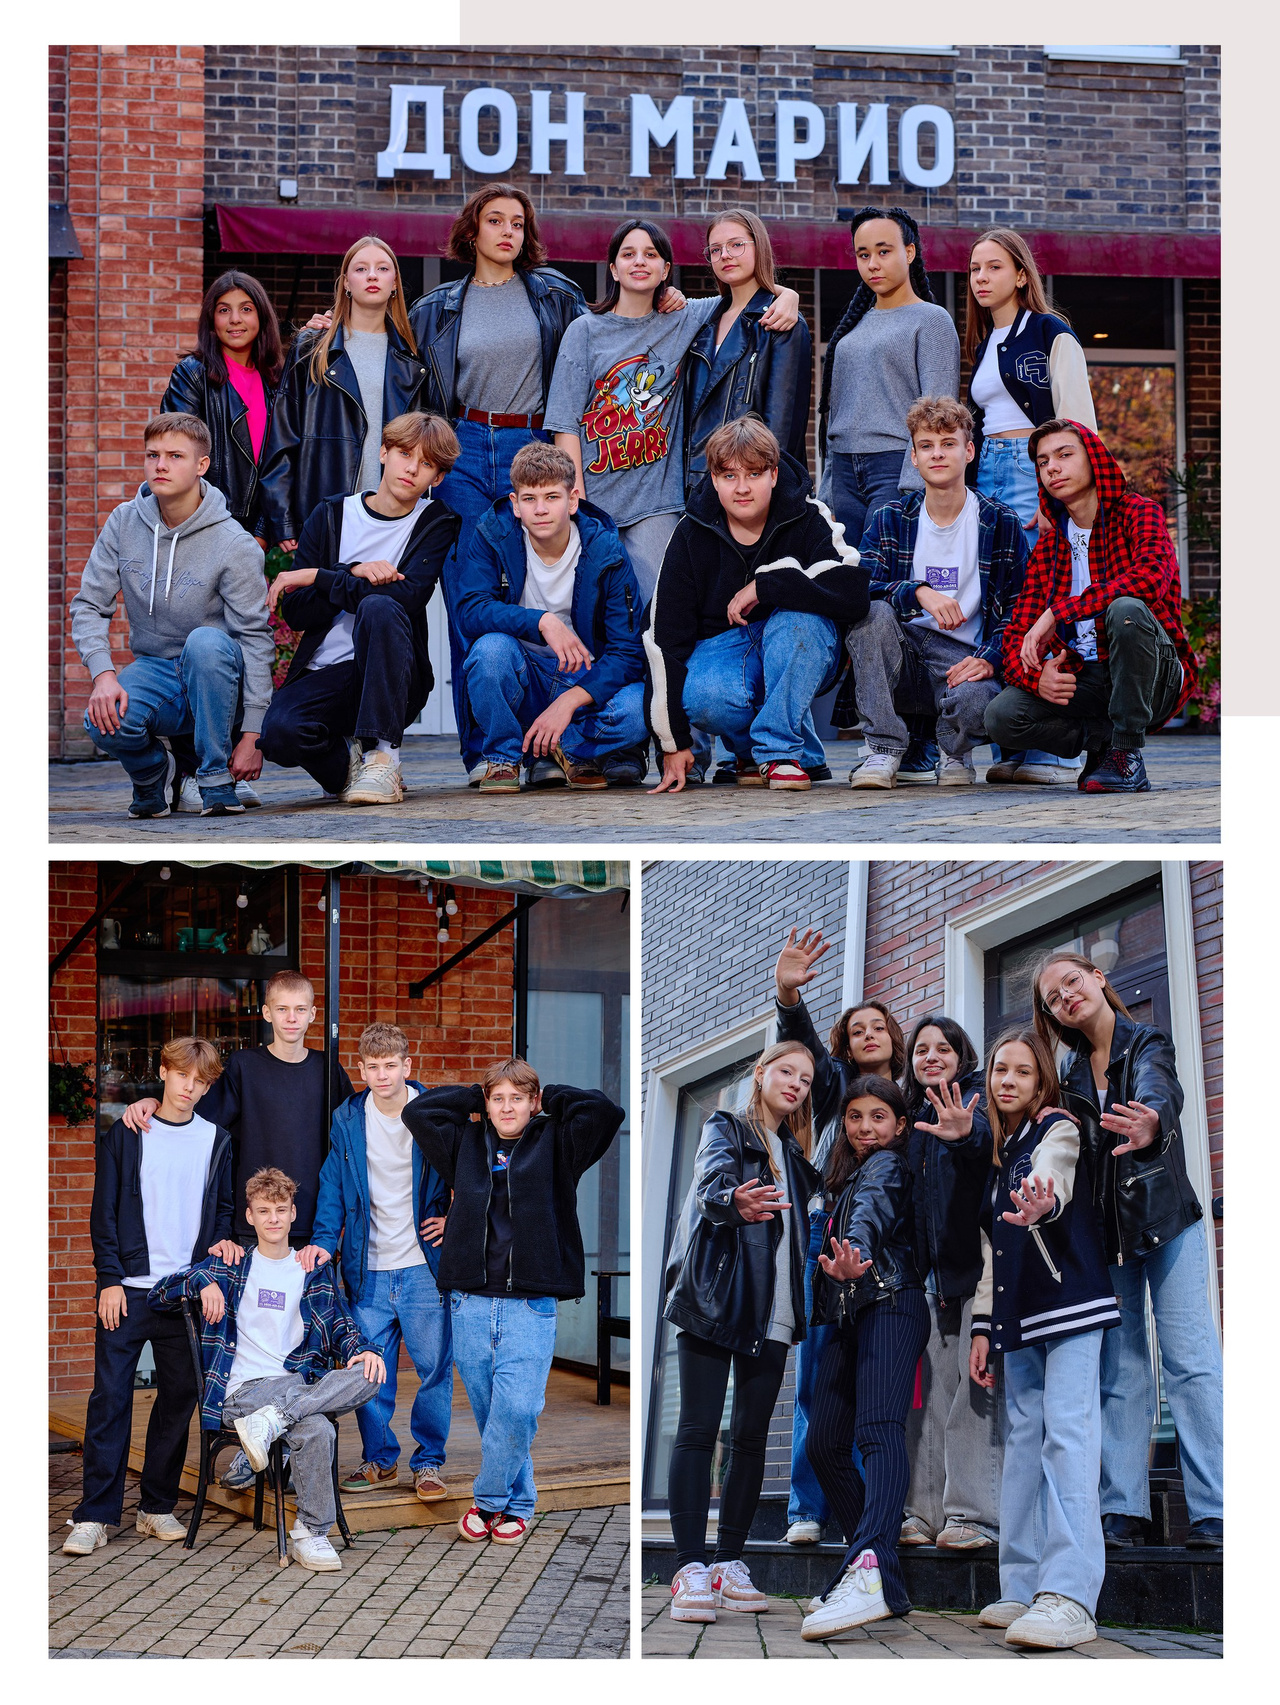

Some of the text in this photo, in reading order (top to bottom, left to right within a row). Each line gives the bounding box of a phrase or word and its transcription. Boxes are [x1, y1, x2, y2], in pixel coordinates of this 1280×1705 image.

[377, 84, 955, 188] ДОН МАРИО
[580, 402, 641, 442] TOM
[588, 424, 670, 473] JERRY
